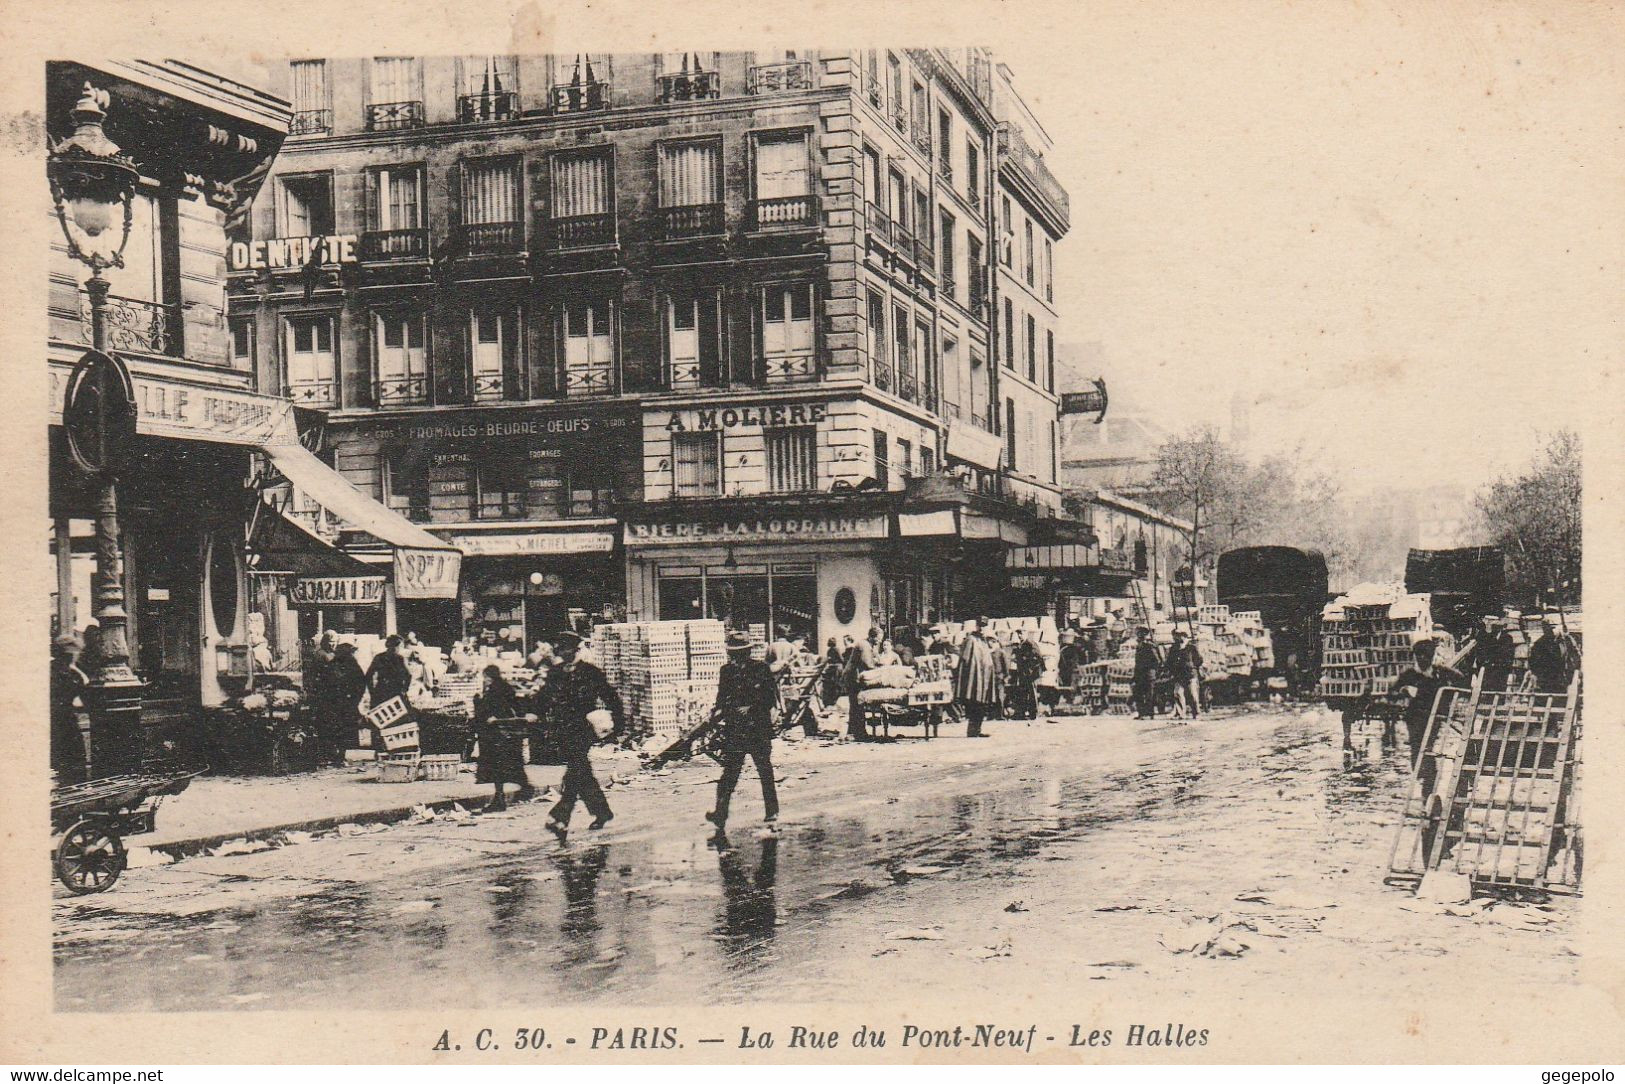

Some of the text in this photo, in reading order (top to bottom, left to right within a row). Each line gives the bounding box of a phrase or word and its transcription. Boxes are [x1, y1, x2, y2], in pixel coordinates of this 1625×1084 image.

[232, 234, 358, 269] DENTISTE
[409, 424, 478, 438] FROMAGES
[487, 421, 538, 436] BEURRE
[547, 418, 591, 432] OEUFS
[665, 411, 685, 431] A
[723, 521, 749, 535] LA
